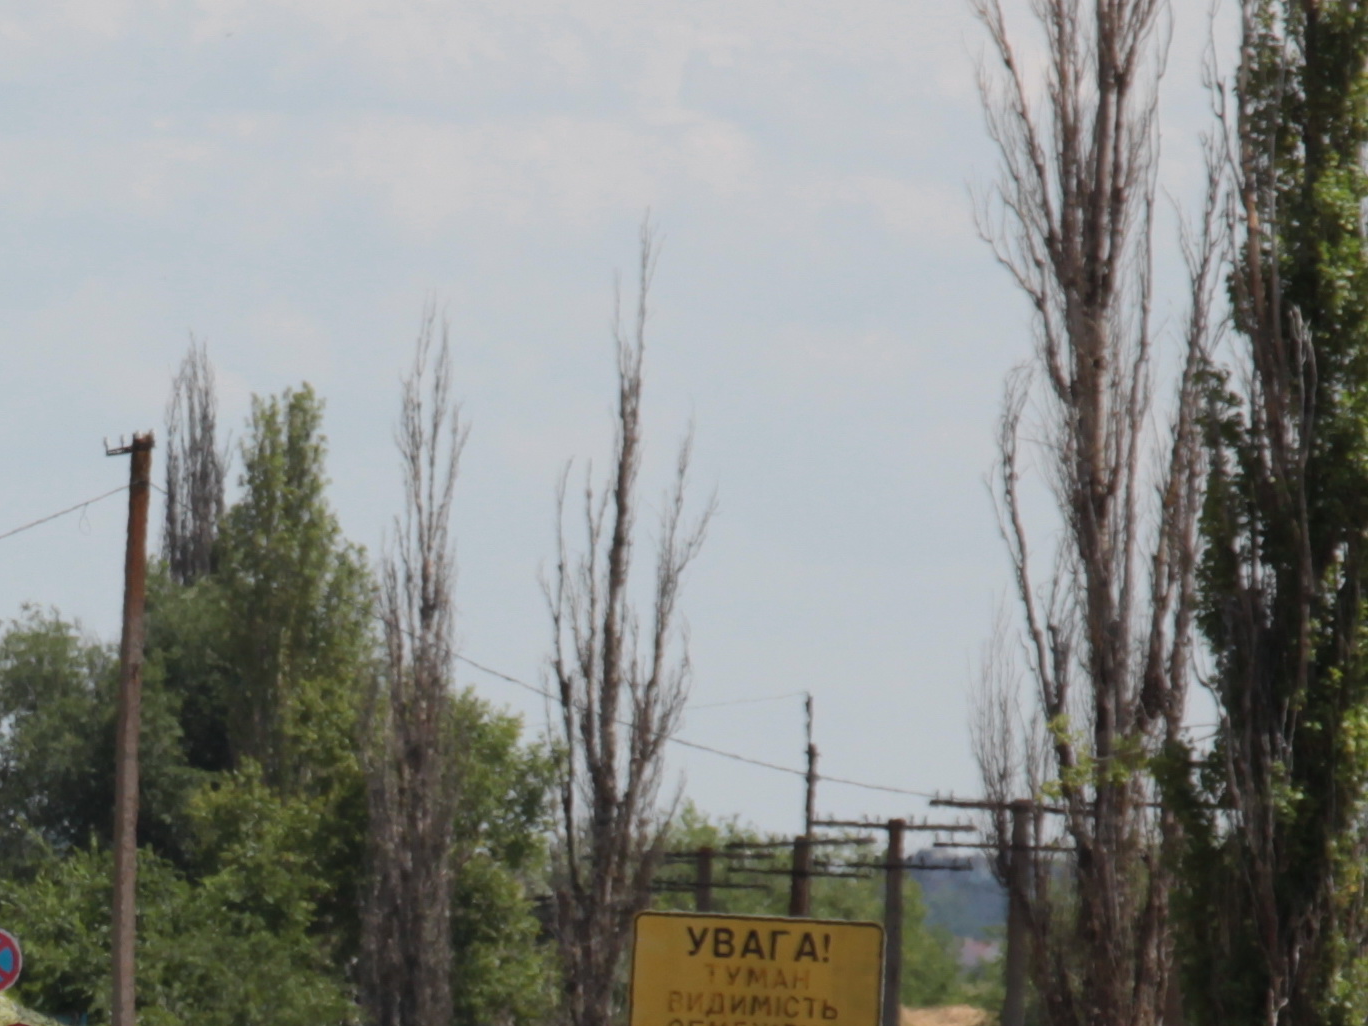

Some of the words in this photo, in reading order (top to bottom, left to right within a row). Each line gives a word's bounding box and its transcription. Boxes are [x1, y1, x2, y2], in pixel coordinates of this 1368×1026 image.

[686, 926, 832, 963] УВАГА!
[704, 963, 811, 990] ТУМАН
[667, 990, 838, 1020] ВИДИМІСТЬ
